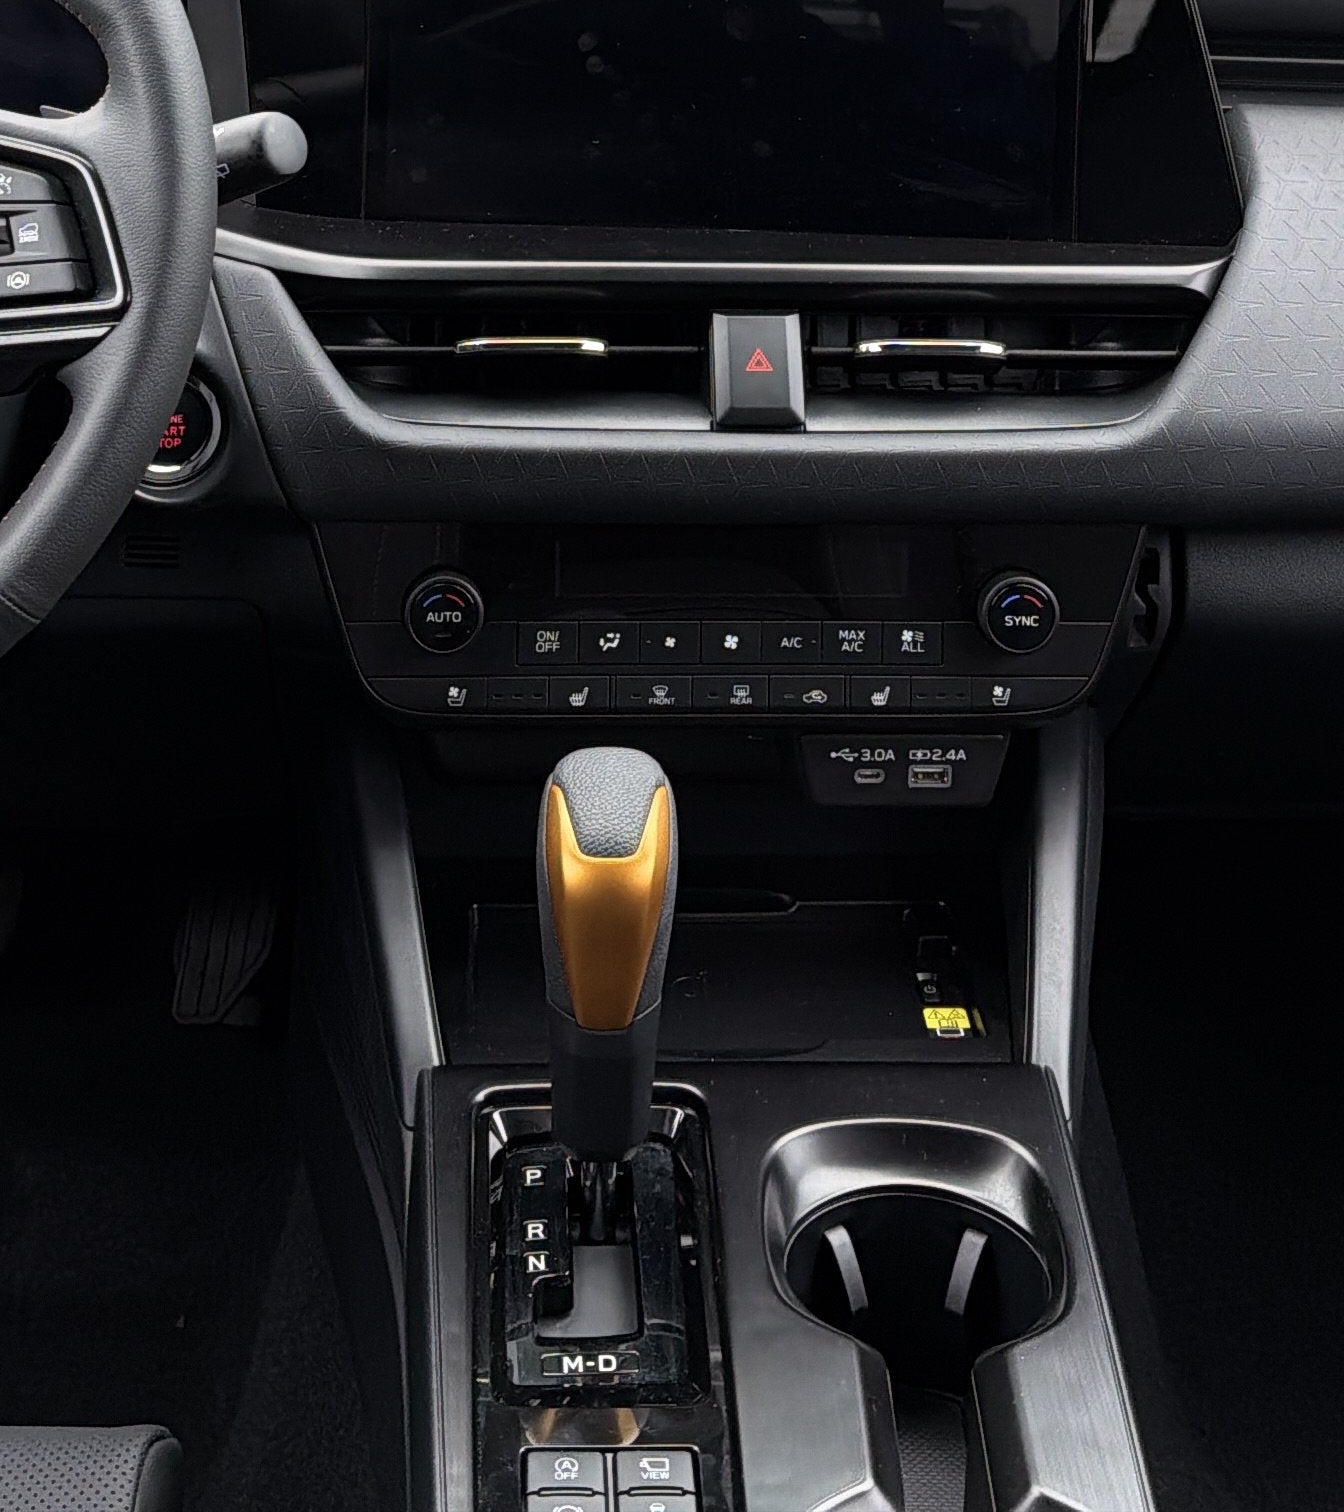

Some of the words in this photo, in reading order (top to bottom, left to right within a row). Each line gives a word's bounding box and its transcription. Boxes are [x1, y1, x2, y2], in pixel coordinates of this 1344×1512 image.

[159, 438, 182, 449] TOP
[425, 611, 462, 623] AUTO
[1005, 616, 1040, 627] SYNC
[838, 630, 866, 641] MAX
[535, 642, 560, 653] OFF
[780, 637, 803, 648] A/C
[841, 641, 864, 652] A/C
[901, 641, 925, 653] ALL
[648, 697, 676, 705] FRONT
[730, 697, 753, 705] REAR
[860, 749, 896, 761] 3.0A
[932, 749, 967, 761] 2.4A
[526, 1169, 542, 1185] P
[527, 1223, 545, 1239] R
[528, 1255, 546, 1272] N
[562, 1354, 617, 1374] M-D
[554, 1471, 579, 1481] OFF
[640, 1471, 670, 1480] VIEW
